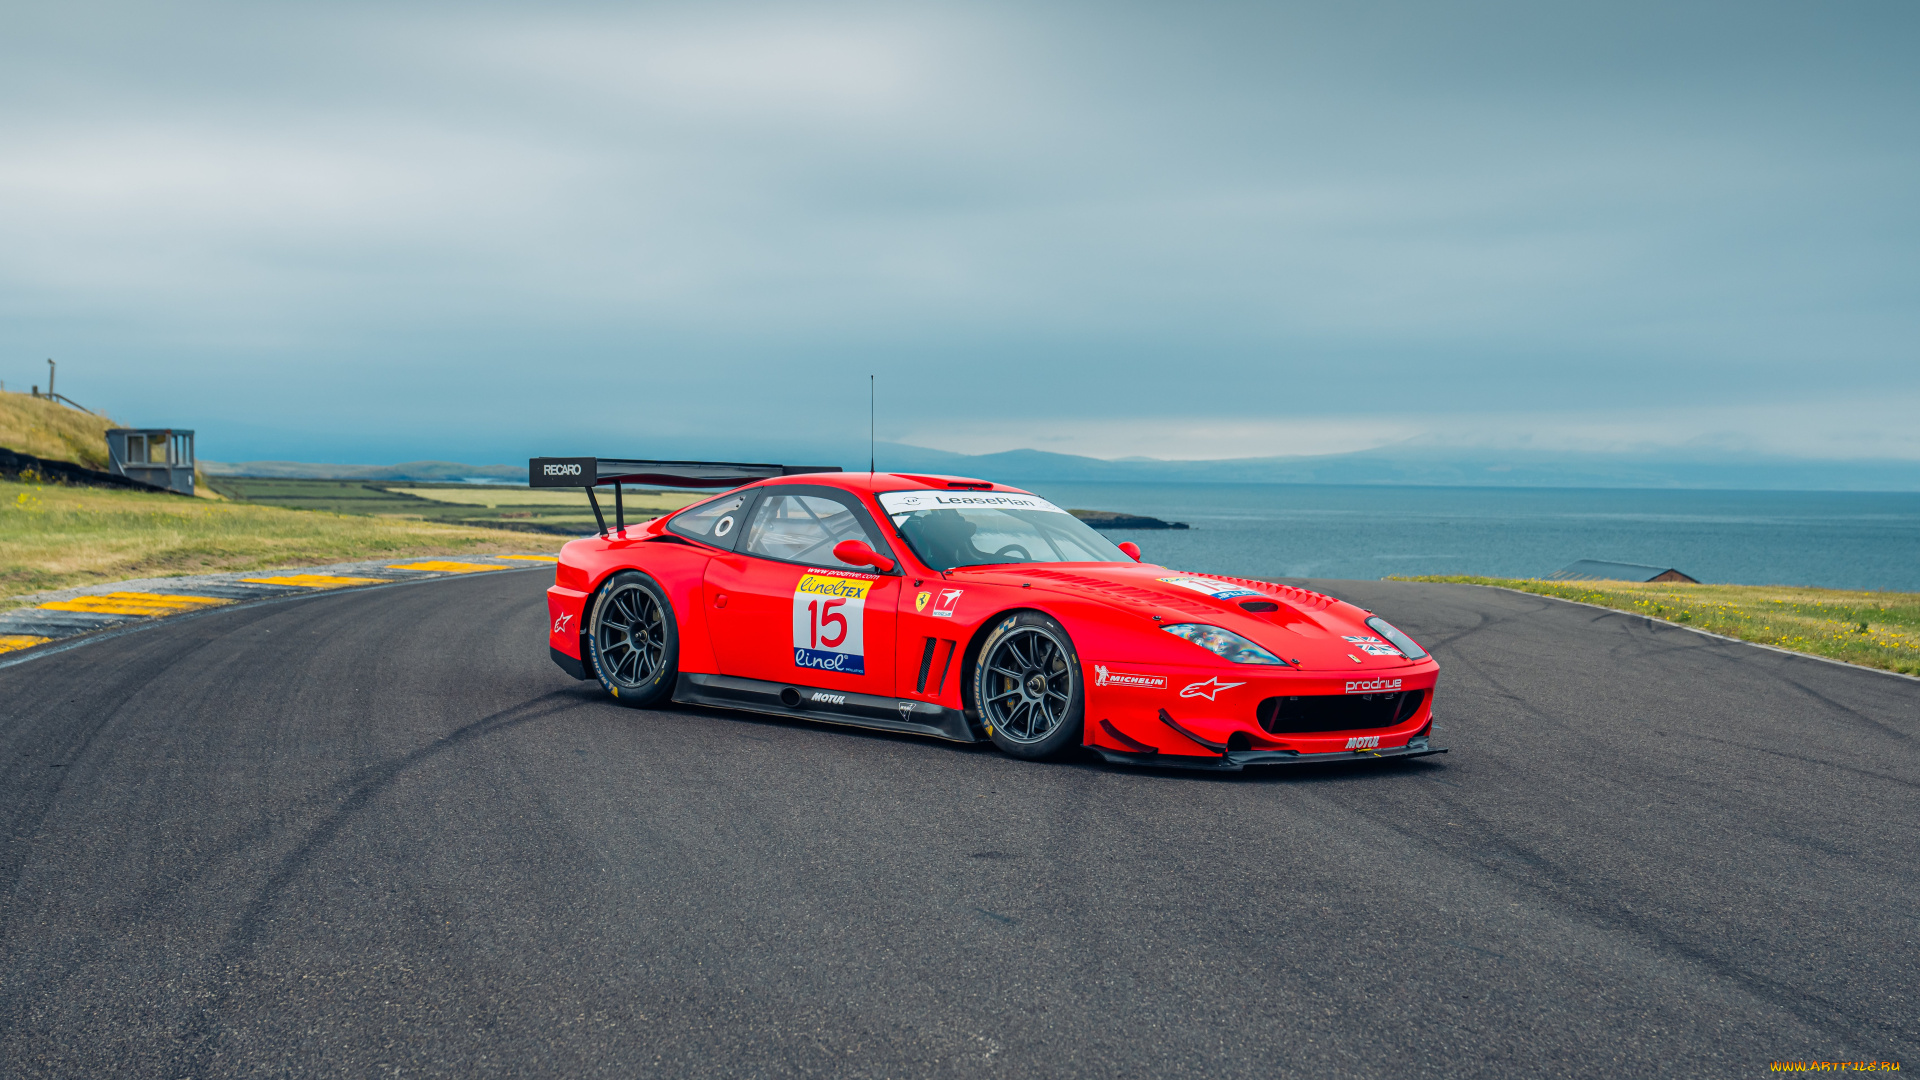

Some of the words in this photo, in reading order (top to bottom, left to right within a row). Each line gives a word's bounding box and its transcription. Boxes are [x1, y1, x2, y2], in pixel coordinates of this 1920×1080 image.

[543, 464, 582, 476] RECARO
[935, 496, 1036, 507] LeasePlan
[807, 567, 881, 580] www.prodrive.com
[807, 598, 848, 649] 15
[589, 638, 609, 685] MICHELIN
[1109, 675, 1164, 685] MICHELIN
[1345, 676, 1402, 693] prodrive
[811, 692, 846, 705] MOTUL
[974, 667, 985, 719] MICHELIN
[1345, 736, 1380, 749] MOTUL
